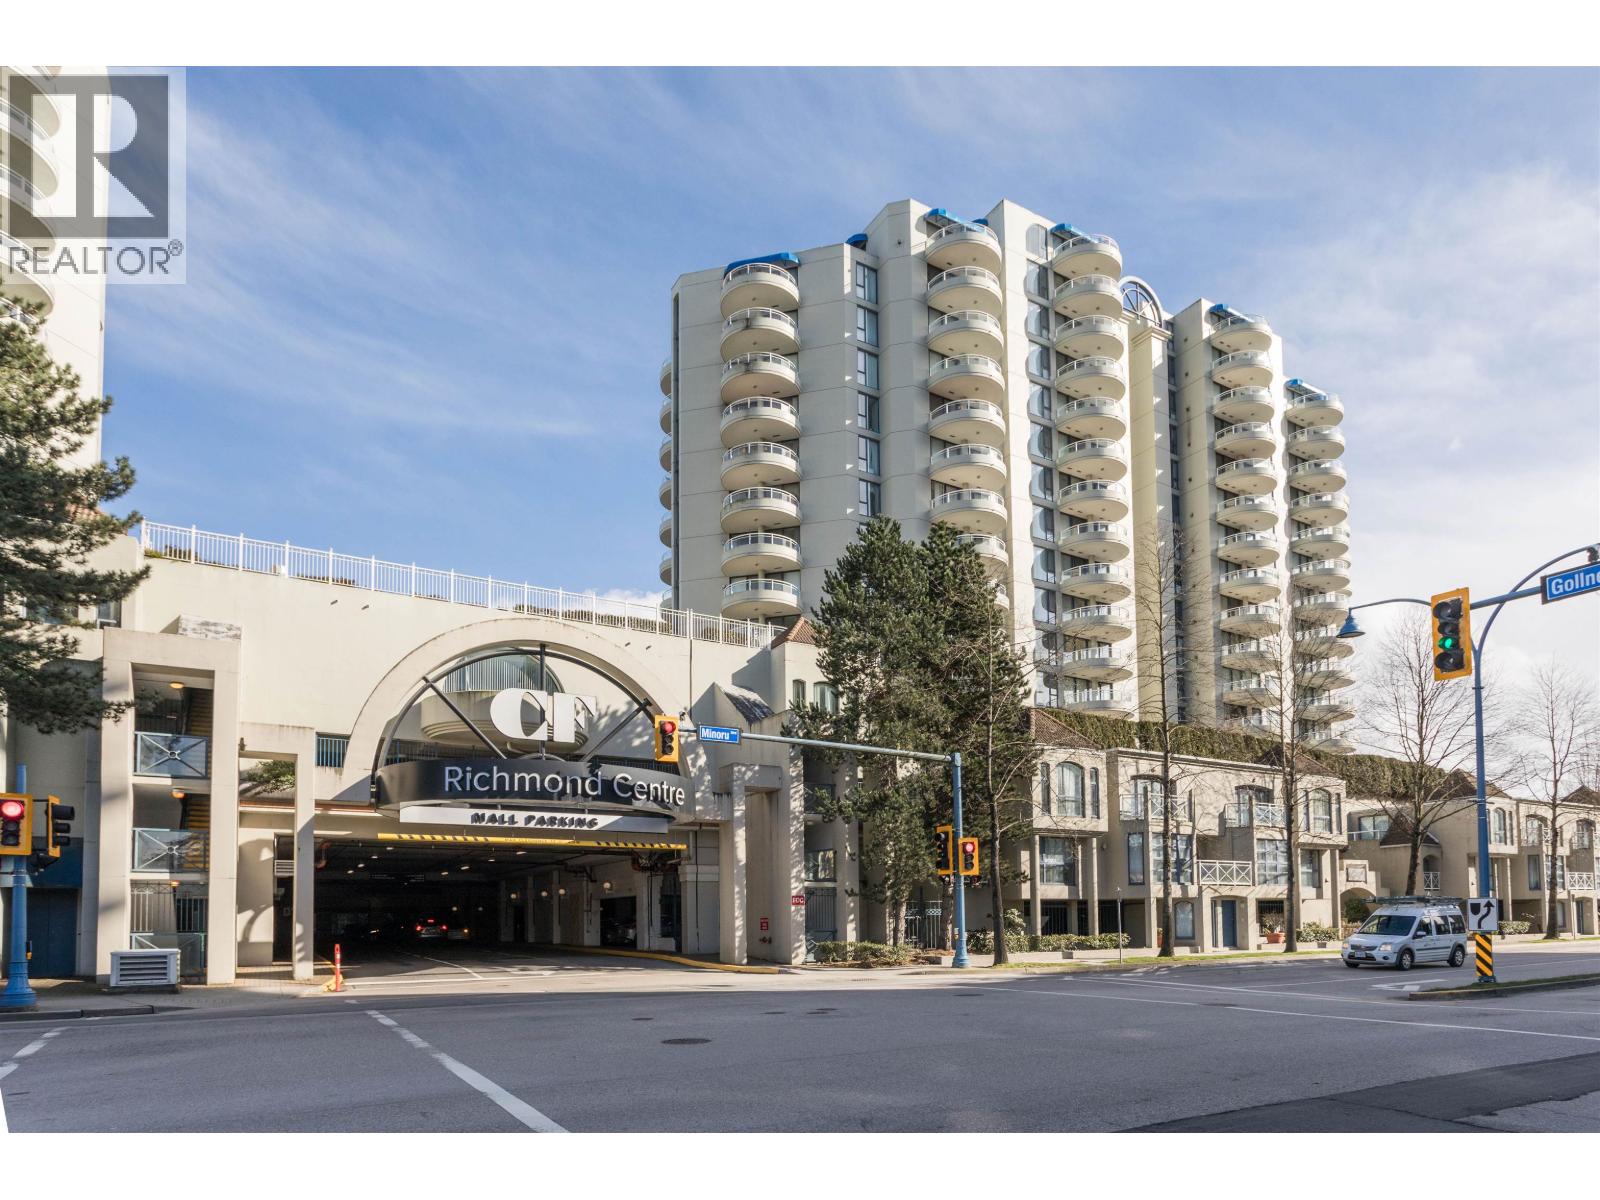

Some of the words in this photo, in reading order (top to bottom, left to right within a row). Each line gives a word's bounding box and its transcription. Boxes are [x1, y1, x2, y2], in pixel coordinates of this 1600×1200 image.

[490, 687, 597, 743] CF
[701, 727, 730, 740] Minoru
[444, 765, 602, 797] Richmond
[613, 773, 685, 806] Centre
[470, 812, 518, 826] MALL
[524, 814, 599, 829] PARKING
